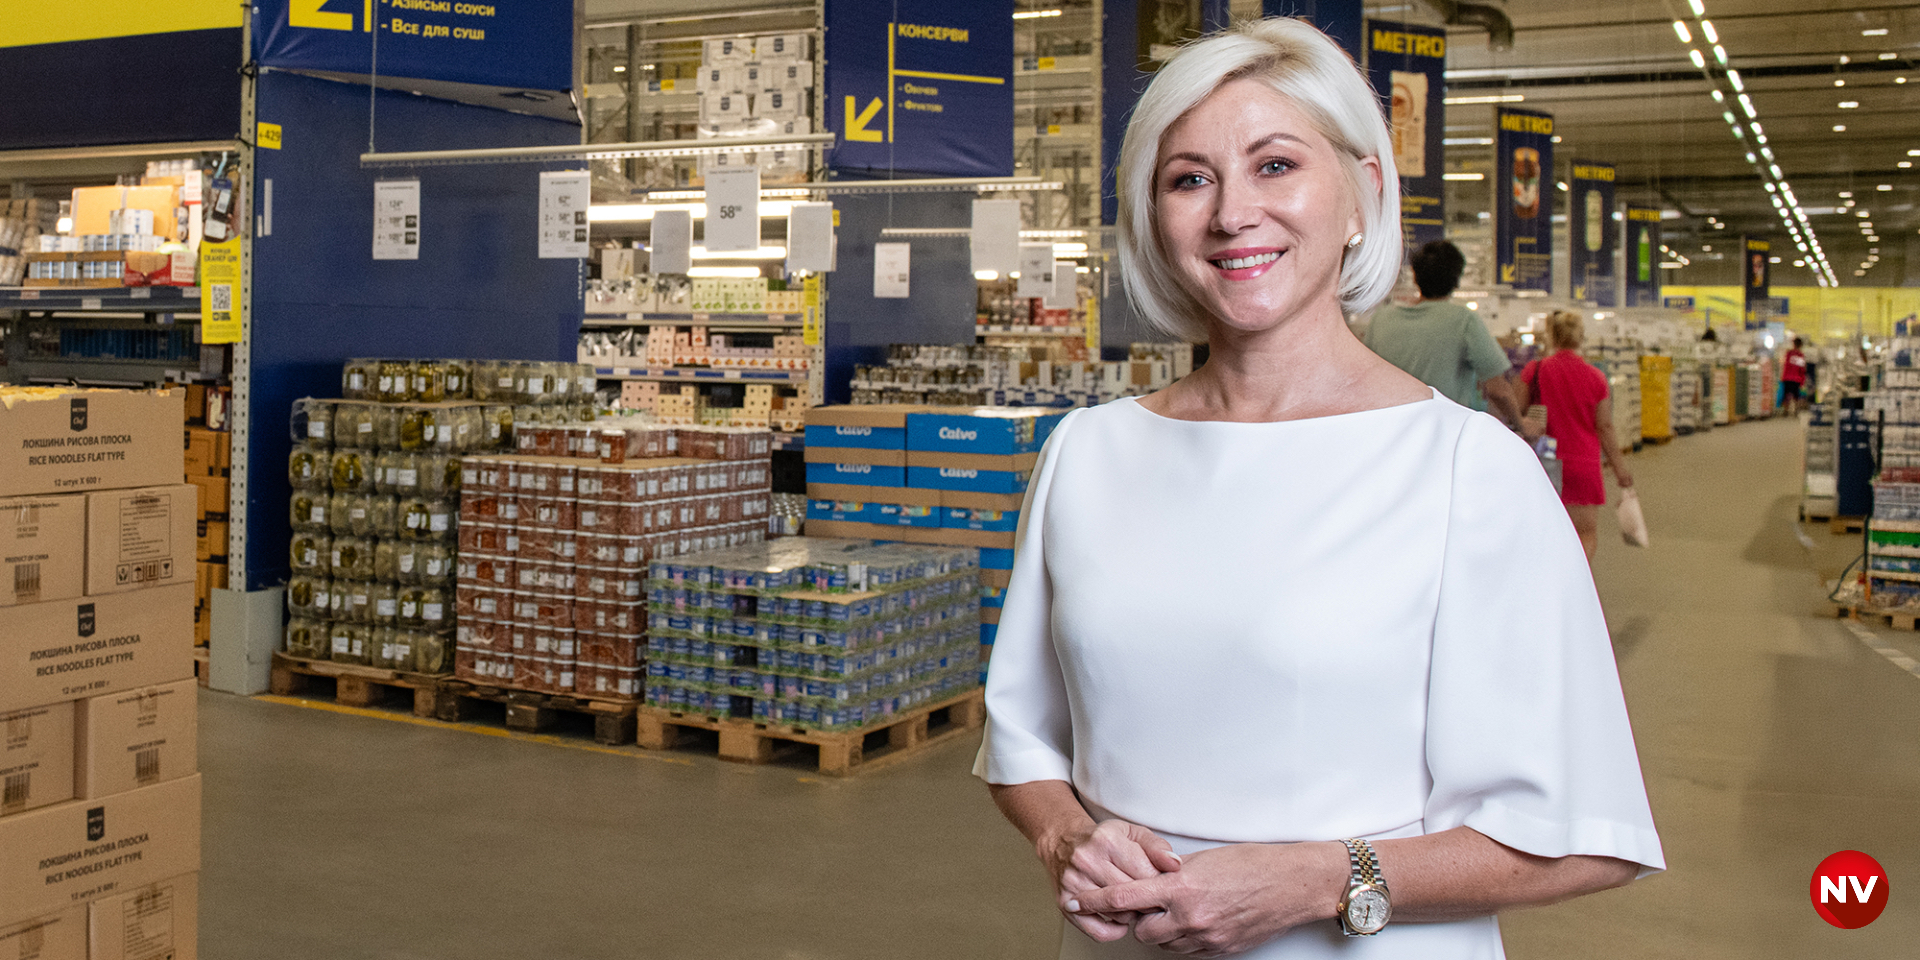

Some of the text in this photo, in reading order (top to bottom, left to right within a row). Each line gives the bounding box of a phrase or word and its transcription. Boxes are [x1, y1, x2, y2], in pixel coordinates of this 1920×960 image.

[1373, 29, 1446, 58] METRO
[1501, 114, 1553, 135] METRO
[22, 434, 132, 449] ЛОКШИНА РИСОВА ПЛОСКА
[938, 426, 978, 441] Calvo
[29, 451, 126, 466] RICE NOODLES FLAT TYPE
[29, 634, 141, 661] ЛОКШИНА РИСОВА ПЛОСКА
[36, 651, 134, 677] RICE NOODLES FLAT TYPE
[38, 832, 149, 871] ЛОКШИНА РИСОВА ПЛОСКА
[45, 850, 142, 885] RICE NOODLES FLAT TYPE
